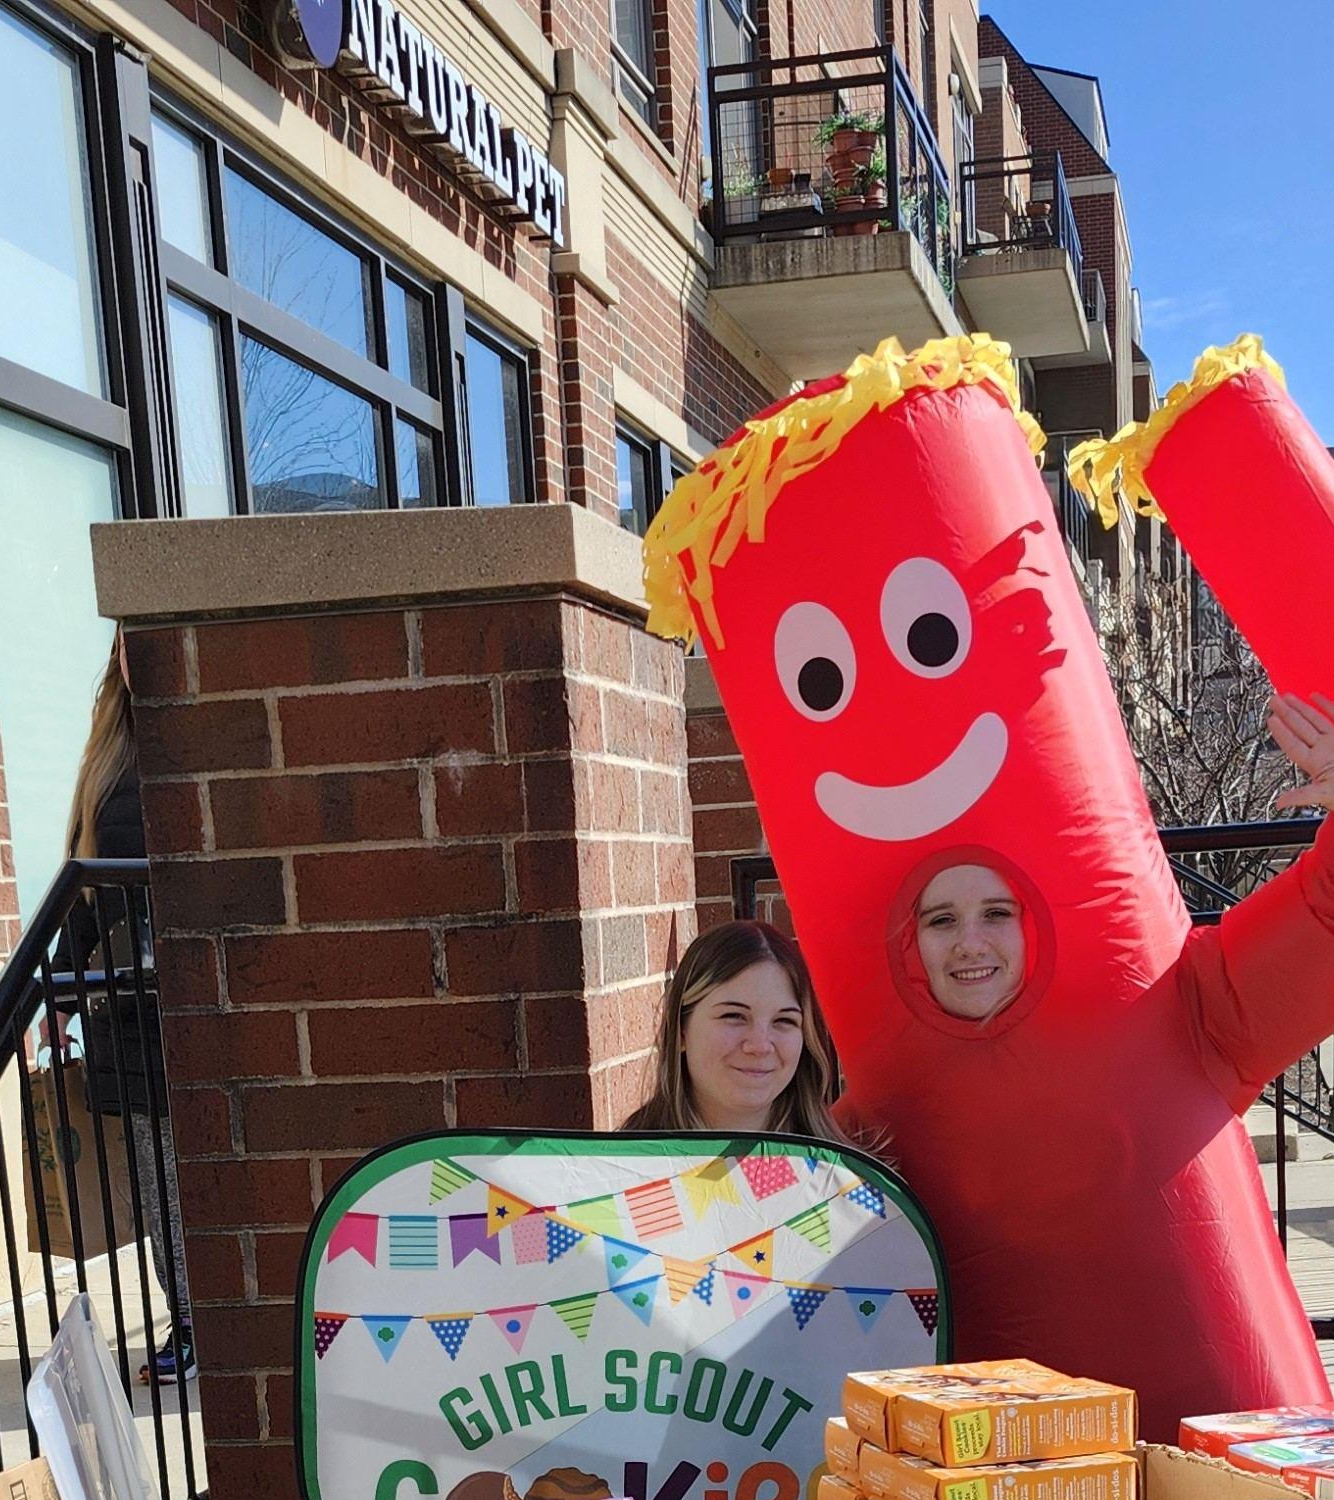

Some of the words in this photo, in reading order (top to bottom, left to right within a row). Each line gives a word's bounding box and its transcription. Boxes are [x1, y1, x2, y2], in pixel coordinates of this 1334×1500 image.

[349, 0, 513, 200] NATURAL
[513, 128, 565, 248] PET
[438, 1353, 587, 1452] GIRL
[604, 1348, 814, 1454] SCOUT
